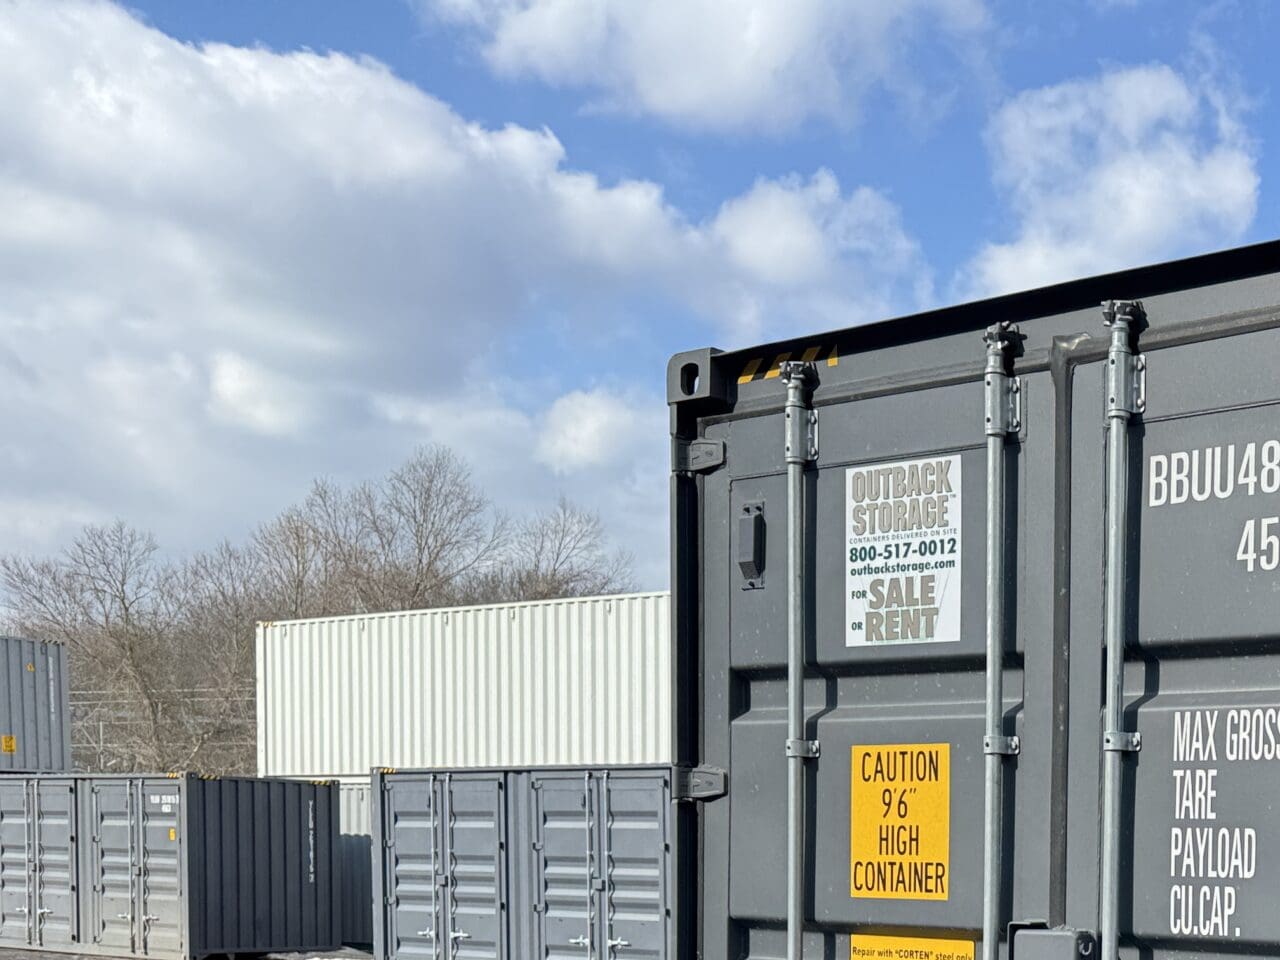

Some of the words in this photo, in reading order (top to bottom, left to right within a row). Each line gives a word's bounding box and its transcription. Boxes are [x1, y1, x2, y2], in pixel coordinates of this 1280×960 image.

[852, 460, 953, 503] OUTBACK
[852, 495, 949, 536] STORAGE
[849, 534, 890, 545] CONTAINERS
[891, 531, 928, 541] DELIVERED
[930, 529, 941, 537] ON
[943, 528, 957, 536] SITE
[849, 538, 957, 563] 800-517-0012
[850, 559, 956, 576] outbackstorage.com
[851, 590, 867, 600] FOR
[869, 575, 935, 610] SALE
[851, 622, 863, 631] OR
[865, 607, 939, 642] RENT
[1173, 710, 1218, 762] MAX
[861, 751, 939, 782] CAUTION
[1173, 769, 1217, 820] TARE
[879, 825, 919, 856] HIGH
[1170, 827, 1256, 879] PAYLOAD
[853, 861, 945, 894] CONTAINER
[1170, 885, 1241, 937] CU.CAP.
[852, 946, 876, 958] Repair
[877, 949, 893, 958] with
[895, 949, 934, 960] "CORTEN"
